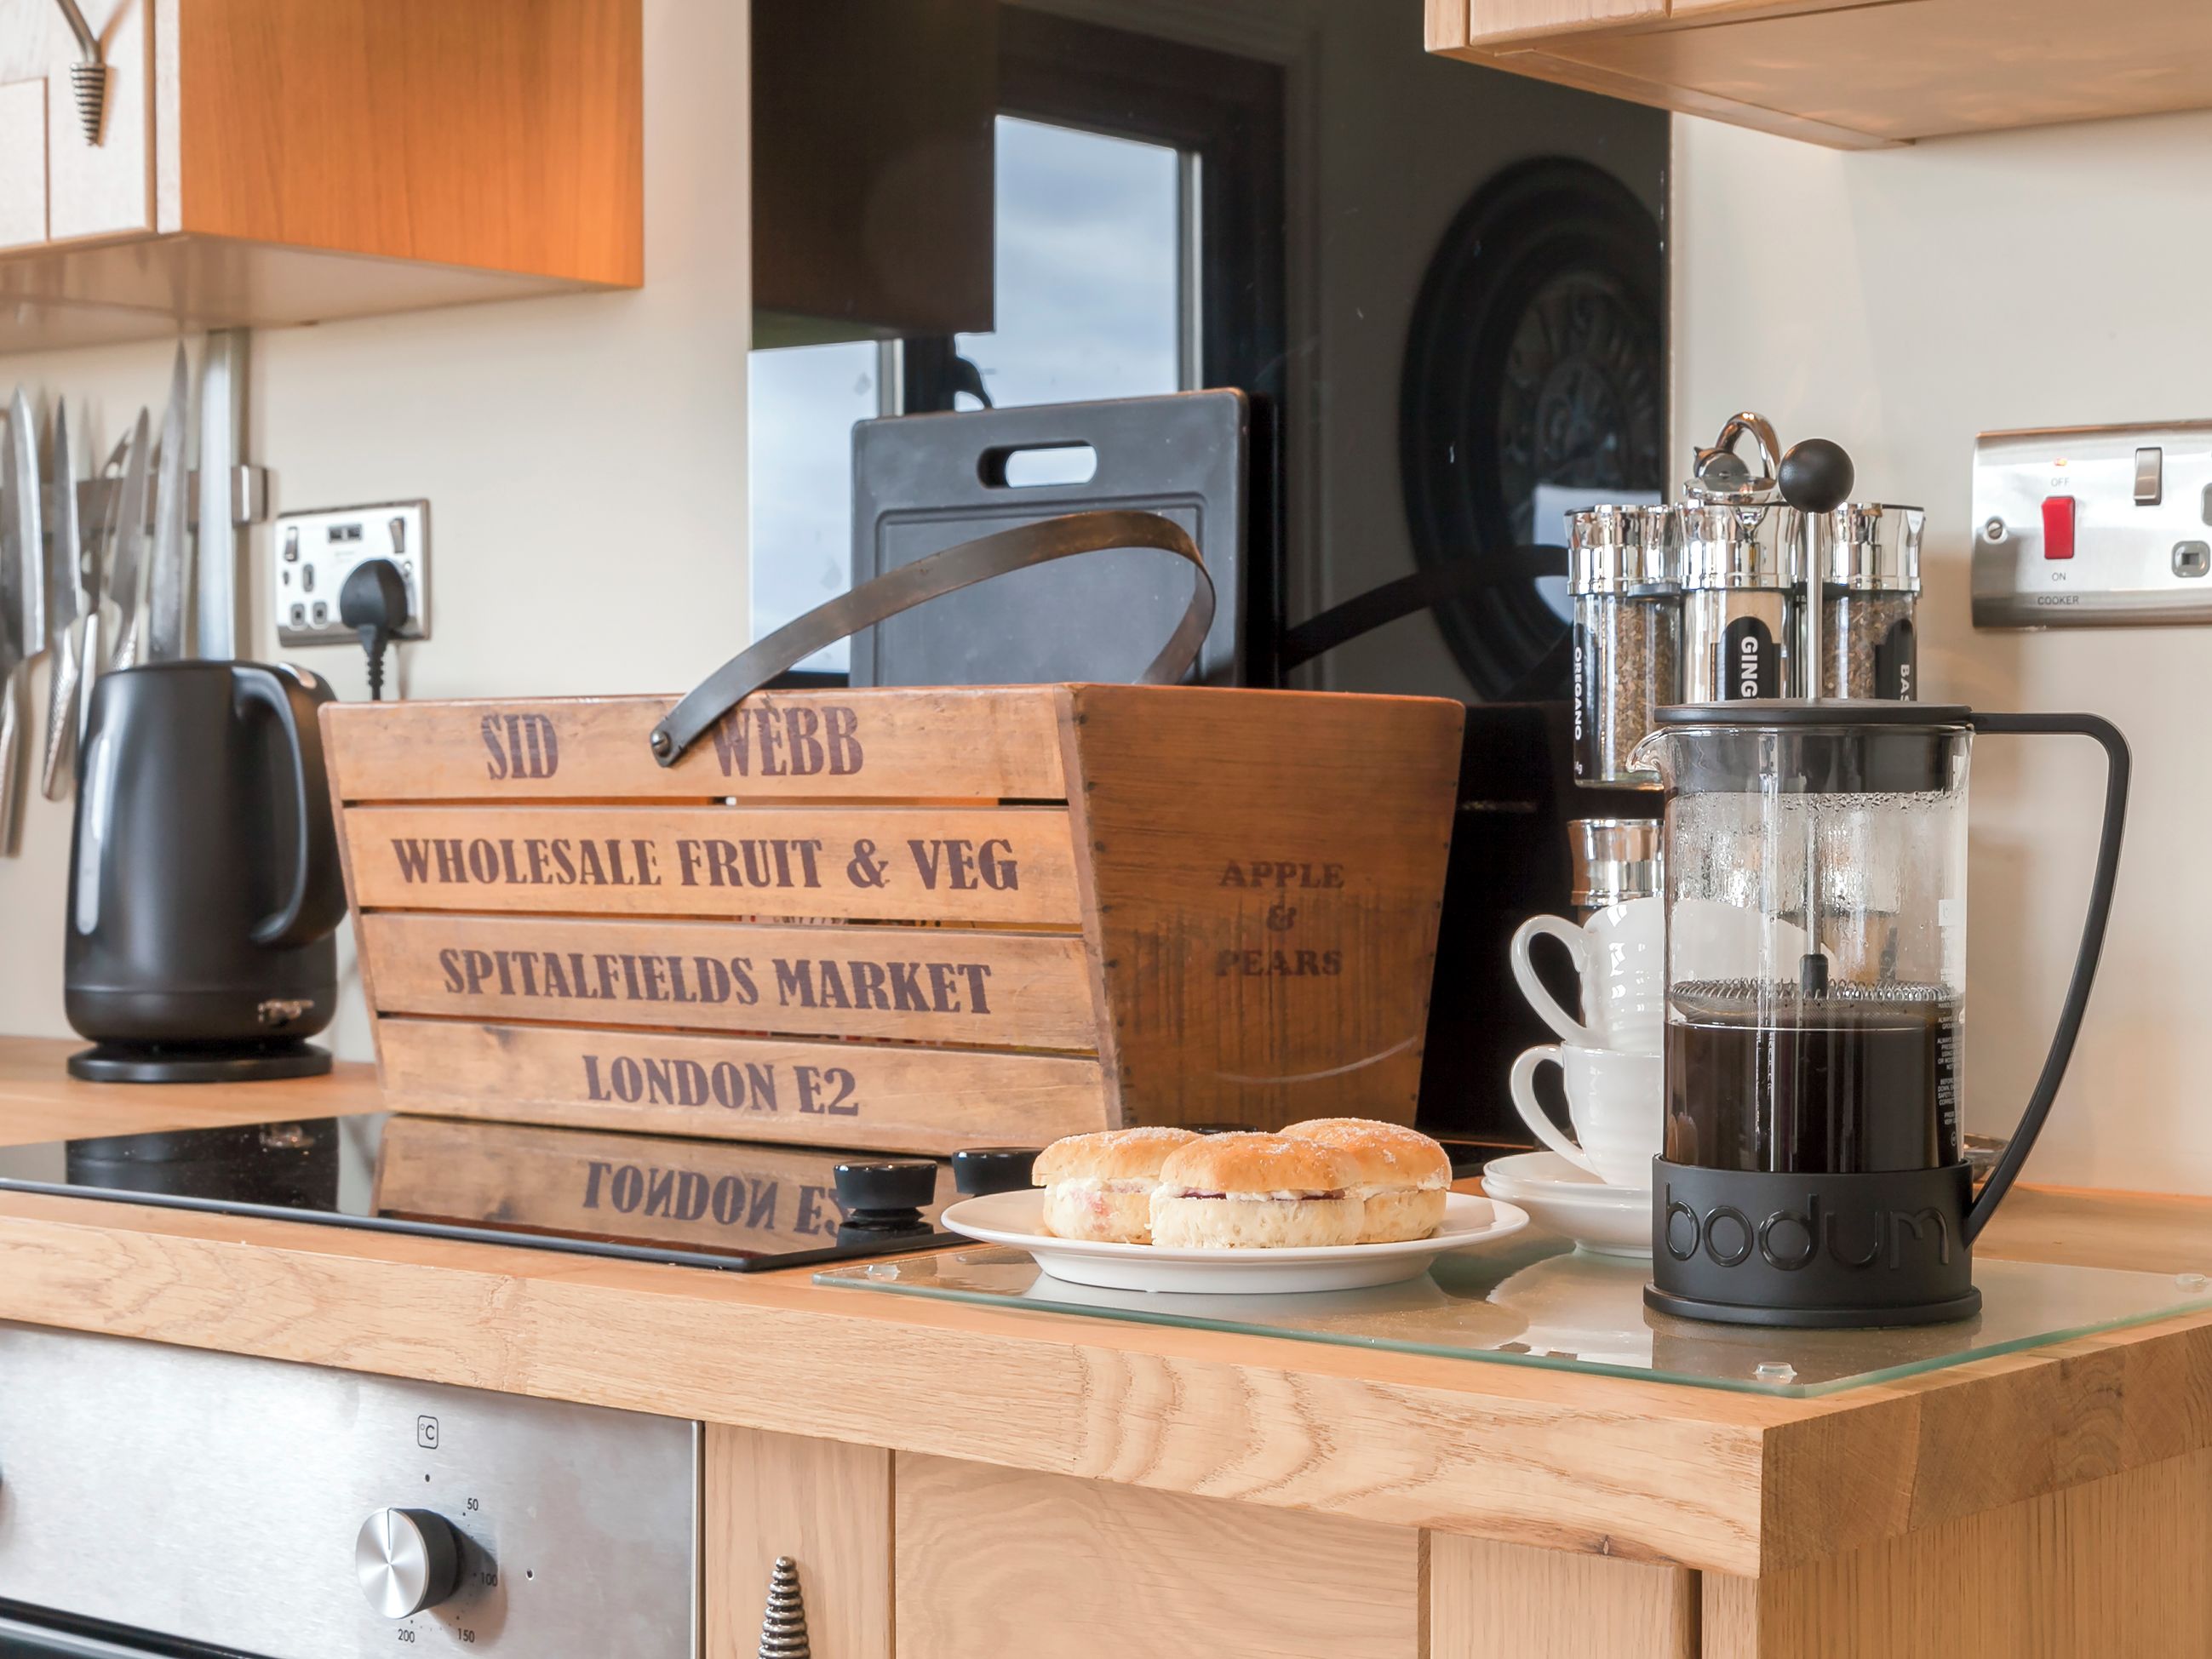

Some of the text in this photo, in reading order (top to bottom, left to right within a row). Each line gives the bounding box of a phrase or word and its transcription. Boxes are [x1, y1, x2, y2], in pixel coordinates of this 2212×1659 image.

[2050, 478, 2070, 487] OFF
[2051, 572, 2066, 581] ON
[2037, 595, 2079, 605] COOKER
[1574, 646, 1583, 741] OREGANO
[481, 706, 863, 781] SID WEBB
[391, 838, 1019, 891] WHOLESALE FRUIT & VEG
[1218, 859, 1345, 890] APPLE
[1265, 903, 1297, 932] &
[1215, 948, 1344, 977] PEARS
[438, 947, 992, 1015] SPITALFIELDS MARKET
[582, 1054, 859, 1116] LONDON E2
[1665, 1181, 1950, 1271] bodum
[467, 1497, 479, 1512] 50
[481, 1572, 498, 1587] 100
[398, 1628, 415, 1644] 200
[457, 1629, 475, 1644] 150
